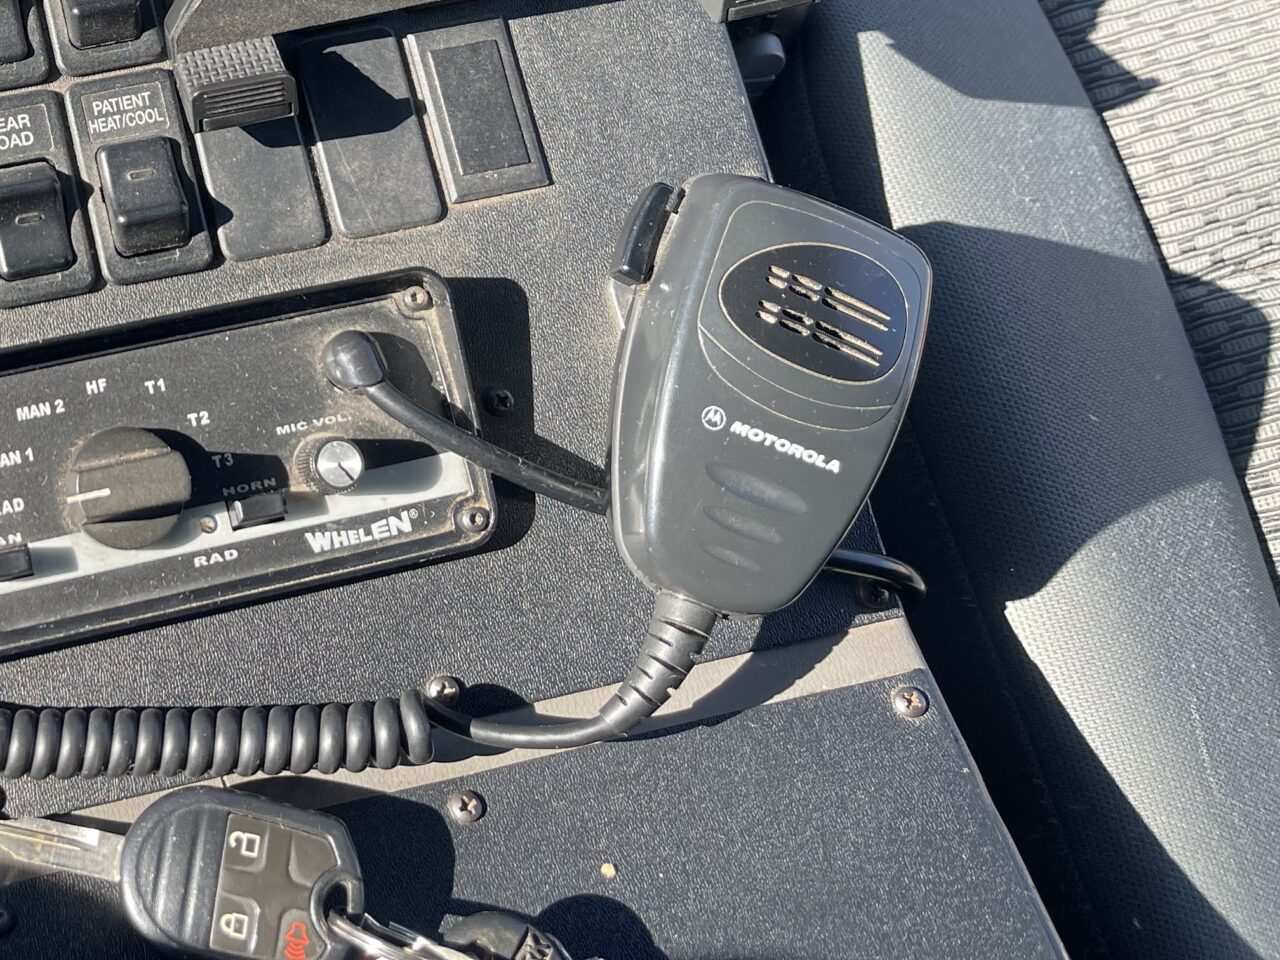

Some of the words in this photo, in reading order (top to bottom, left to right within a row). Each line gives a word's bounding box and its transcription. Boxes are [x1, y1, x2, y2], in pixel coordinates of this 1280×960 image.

[91, 91, 152, 116] PATIENT
[88, 107, 165, 136] HEAT/COOL
[85, 377, 109, 395] HF
[144, 378, 167, 395] T1
[16, 401, 52, 422] MAN
[54, 398, 66, 415] 2
[187, 410, 211, 428] T2
[275, 420, 309, 436] MIC
[24, 446, 35, 463] 1
[730, 420, 841, 475] MOTOROLA
[211, 452, 234, 469] T3
[222, 476, 278, 497] HORN
[193, 548, 239, 568] RAD
